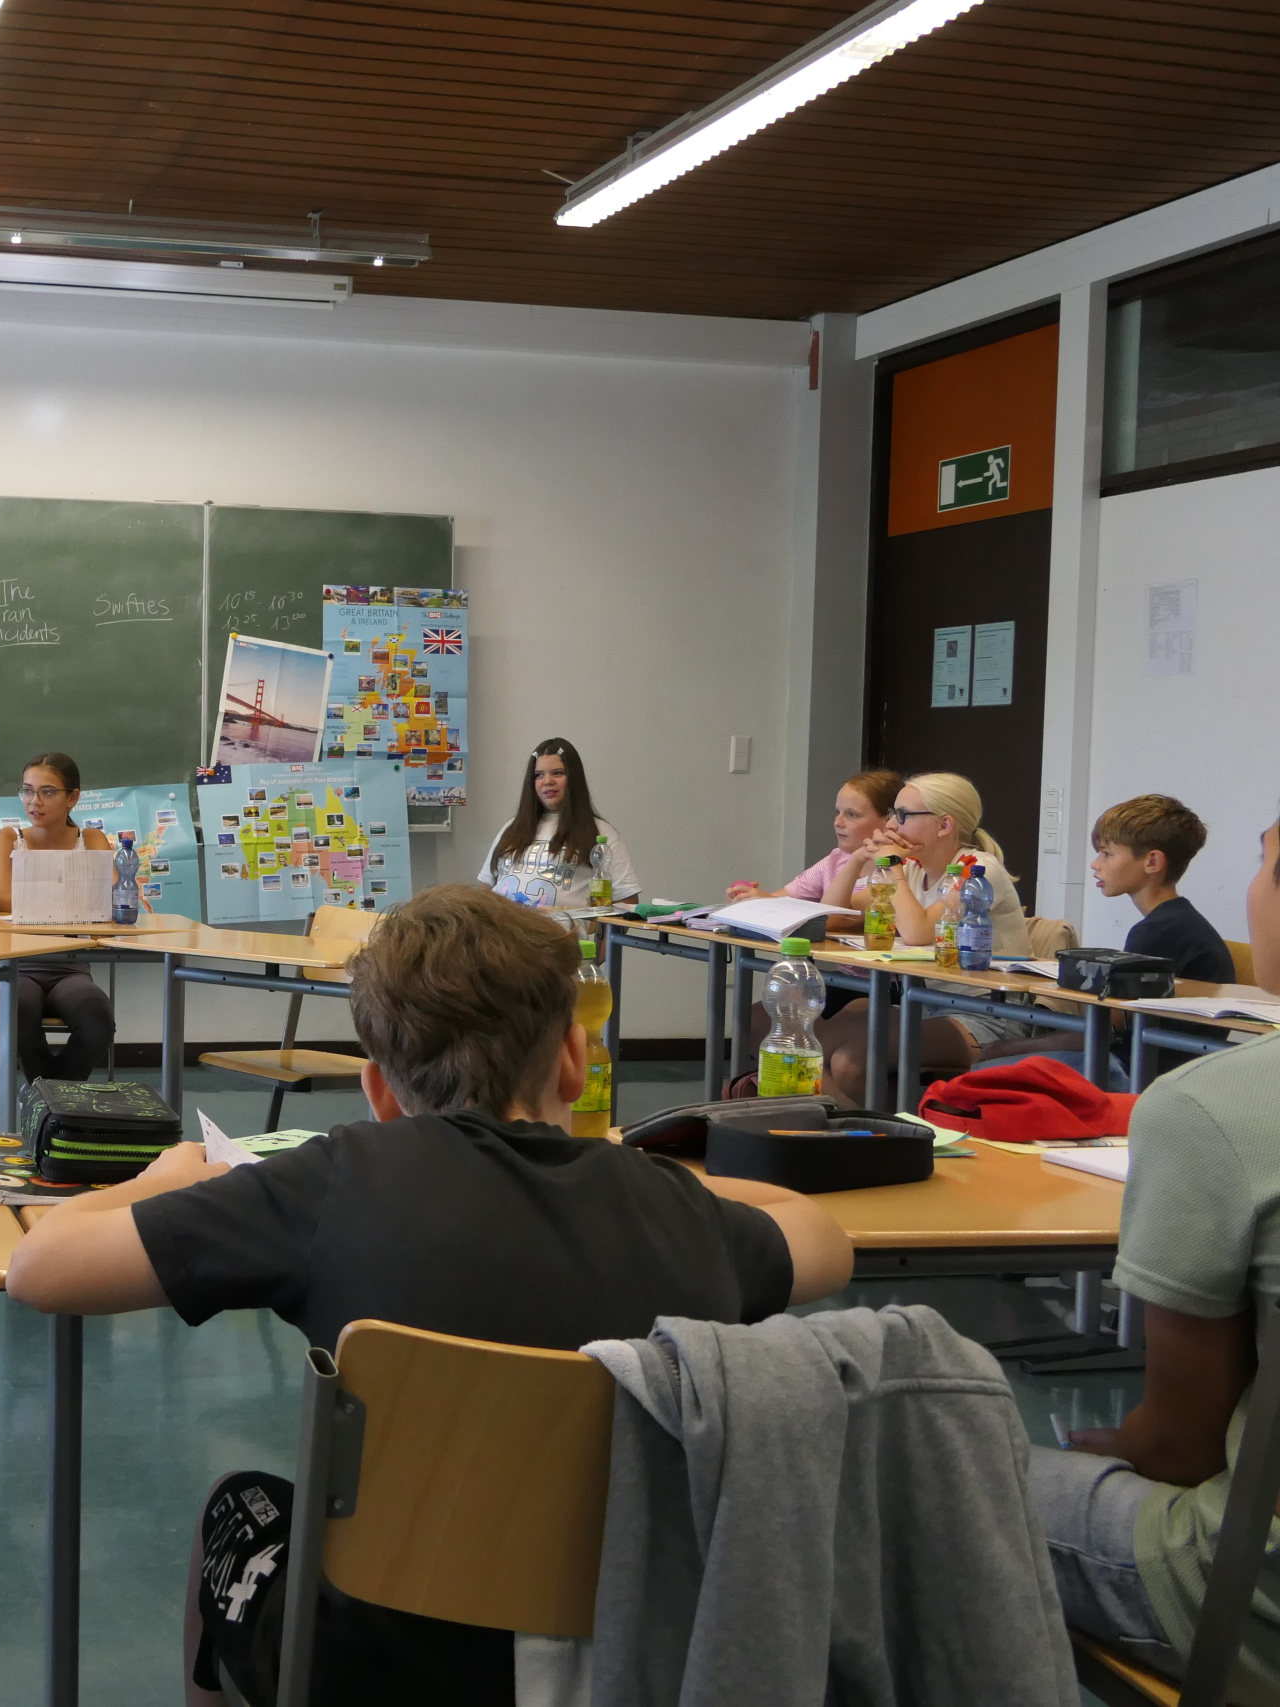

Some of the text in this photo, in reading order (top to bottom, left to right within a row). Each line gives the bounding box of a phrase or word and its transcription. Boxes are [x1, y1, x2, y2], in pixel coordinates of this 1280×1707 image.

[92, 592, 170, 616] Swifties
[339, 608, 398, 618] GREAT BRITAIN
